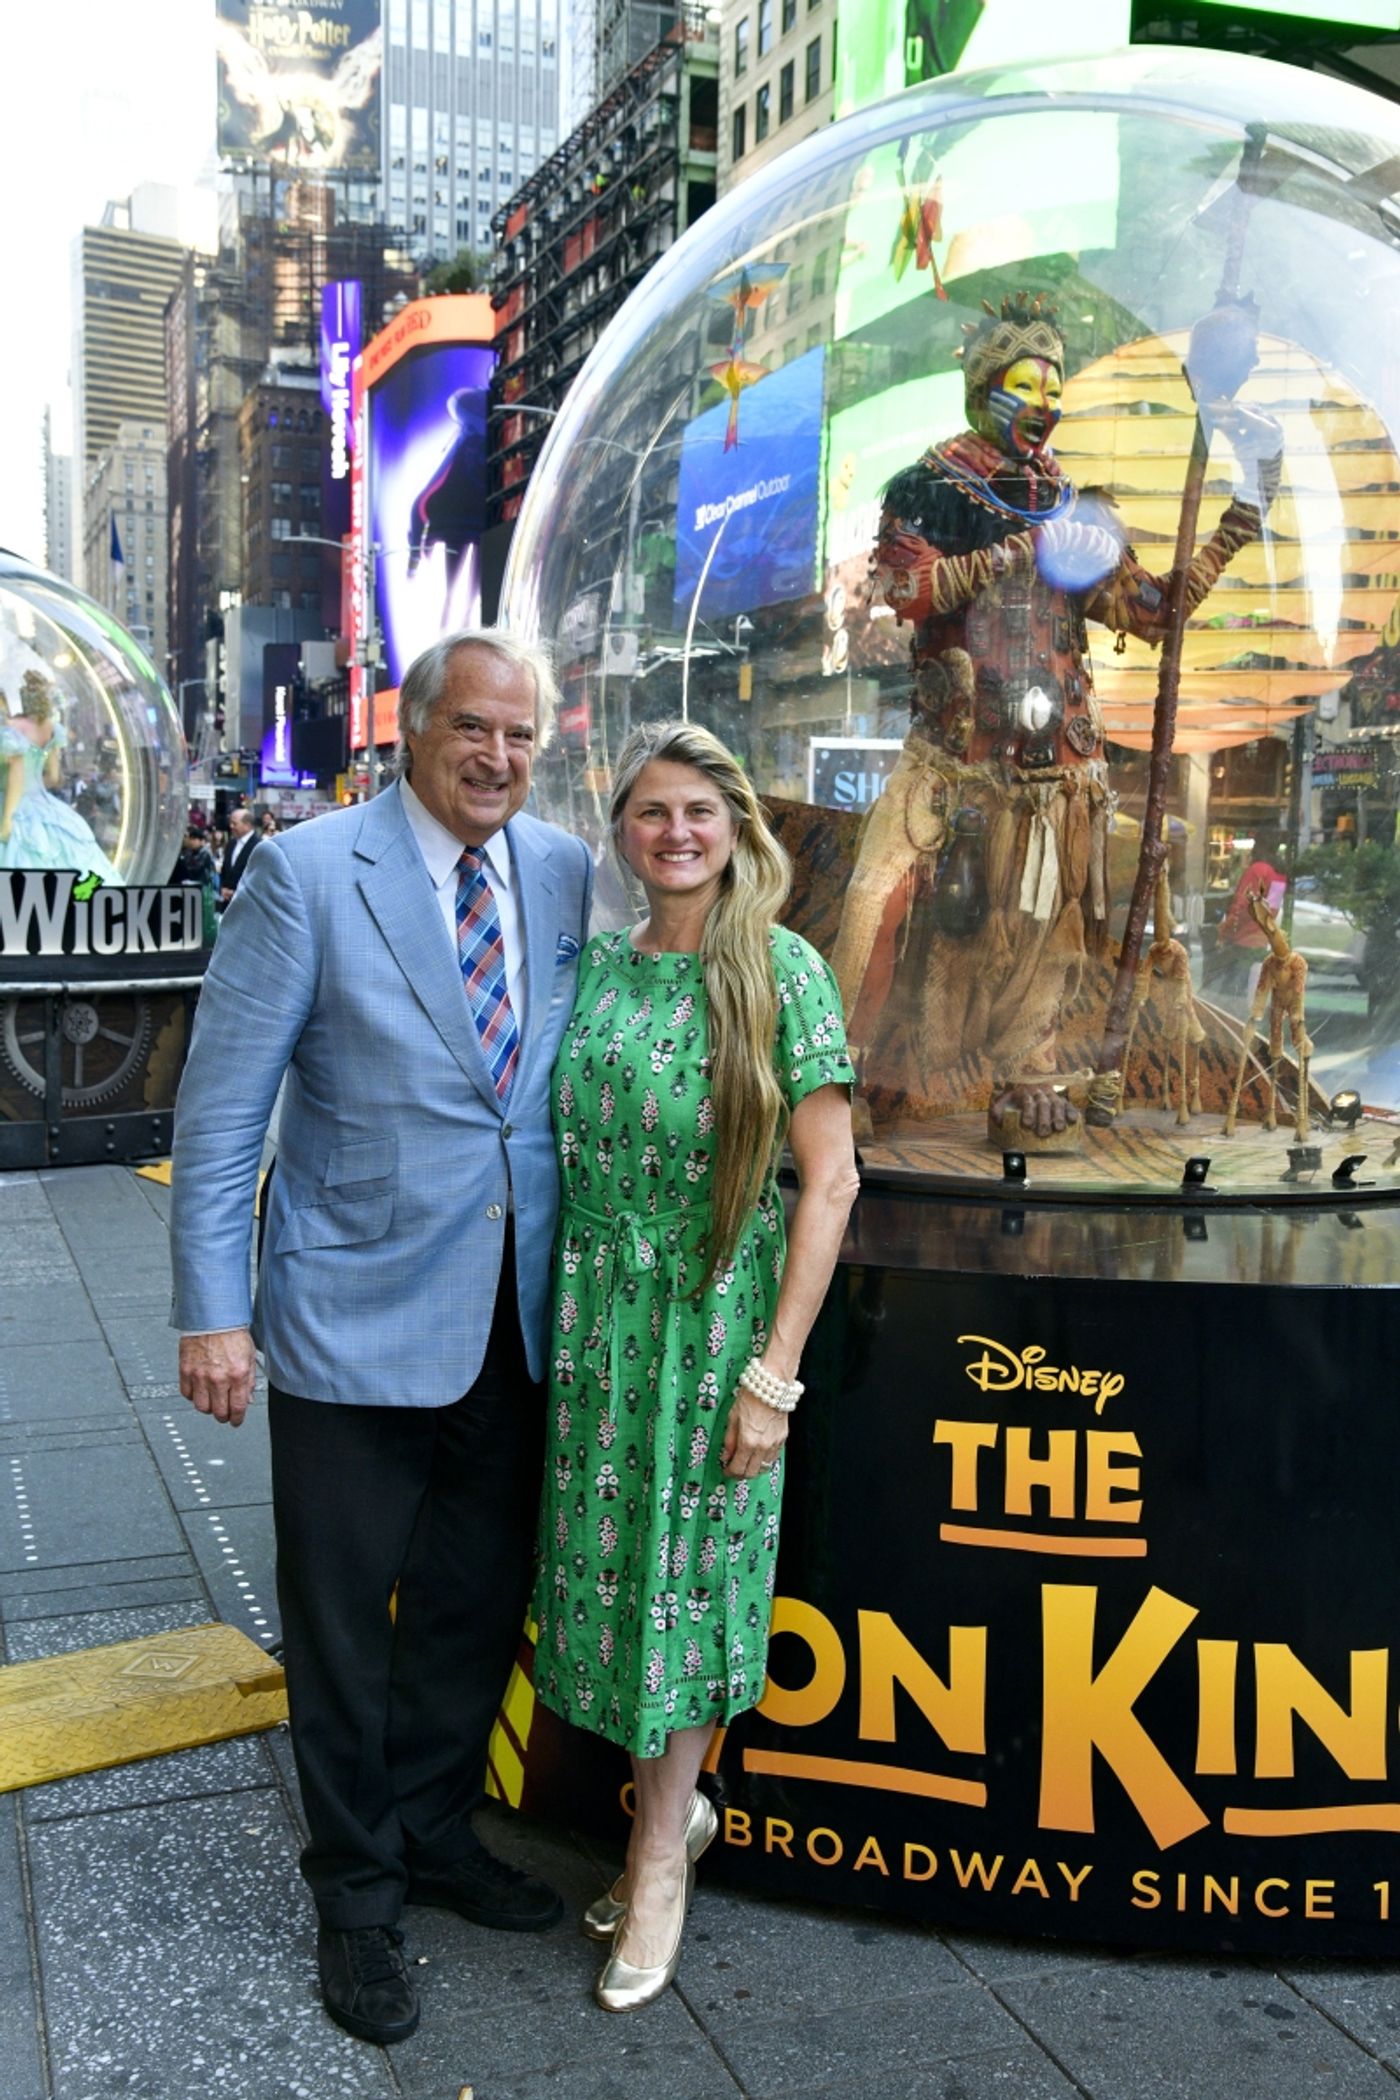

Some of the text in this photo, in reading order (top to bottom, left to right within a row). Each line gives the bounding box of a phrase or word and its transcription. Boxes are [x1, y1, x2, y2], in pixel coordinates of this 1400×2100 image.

[297, 10, 351, 47] Potter
[933, 1419, 1144, 1524] THE
[754, 1583, 1400, 1851] ON KIN
[724, 1807, 1094, 1902] BROADWAY
[1130, 1869, 1336, 1920] SINCE
